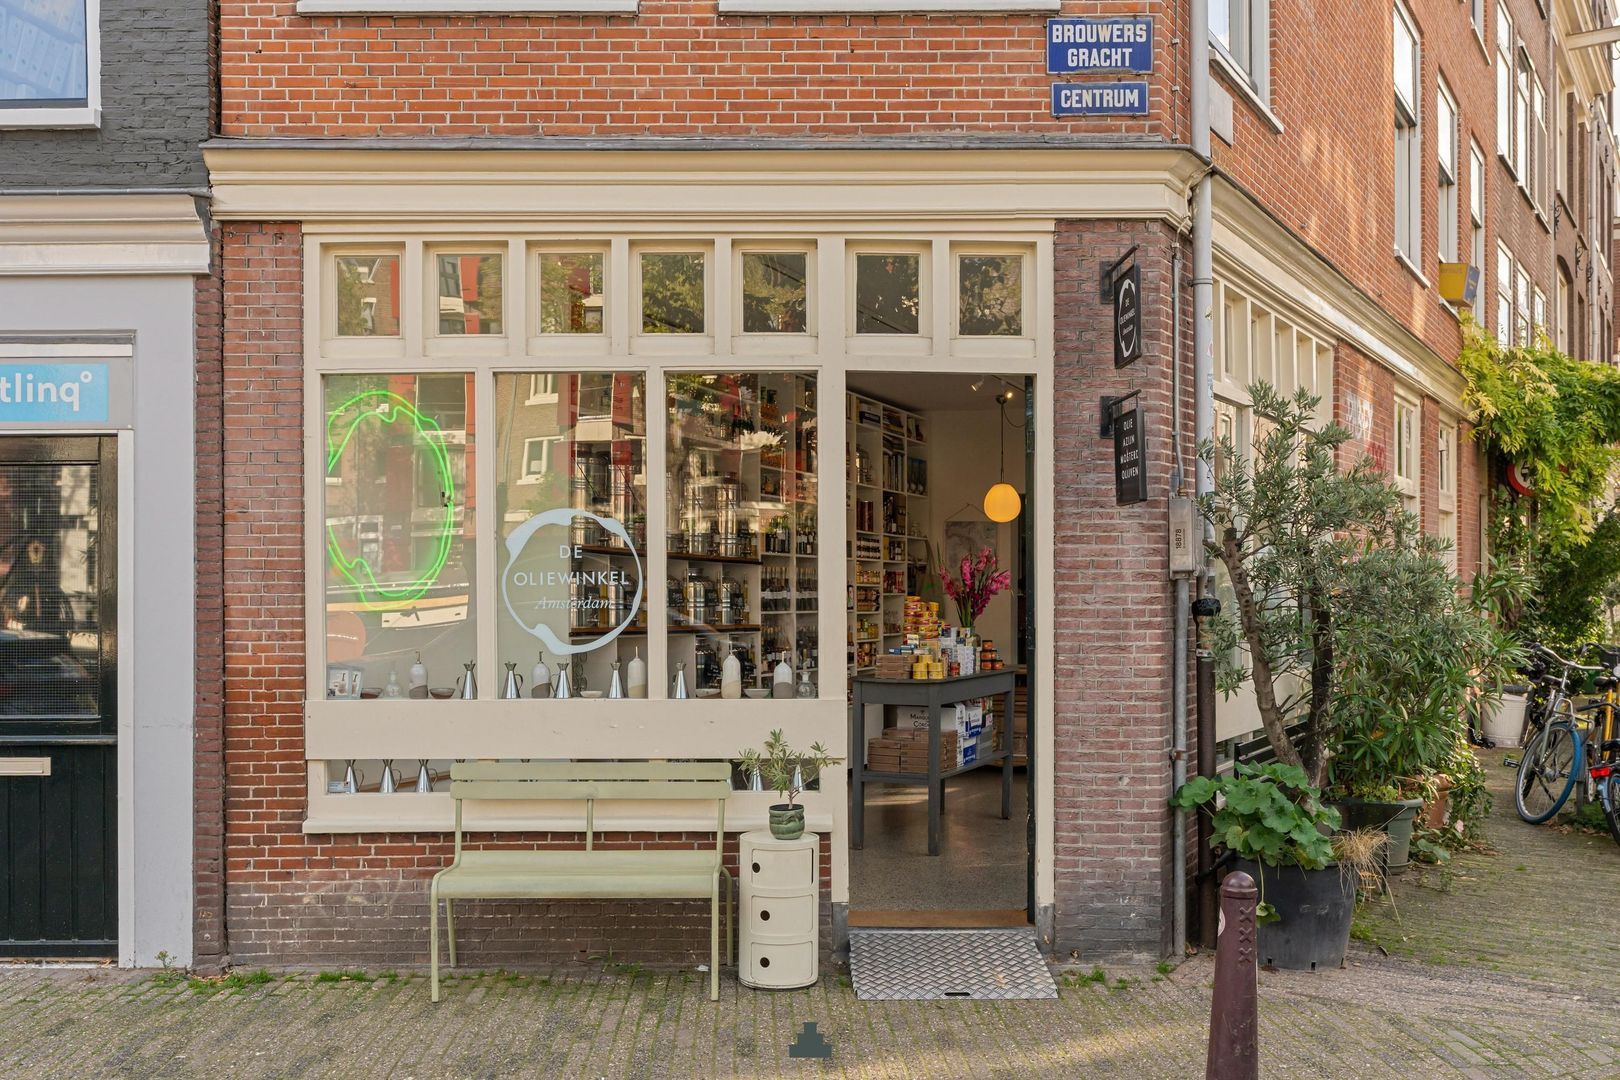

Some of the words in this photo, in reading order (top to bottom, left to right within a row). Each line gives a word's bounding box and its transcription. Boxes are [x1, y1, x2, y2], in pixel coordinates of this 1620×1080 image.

[1052, 24, 1147, 43] BROUWERS
[1067, 48, 1133, 67] GRACHT
[1061, 89, 1139, 108] CENTRUM
[559, 545, 583, 559] DE
[513, 571, 629, 586] OLIEWINKEL
[535, 595, 614, 609] Amsterdam
